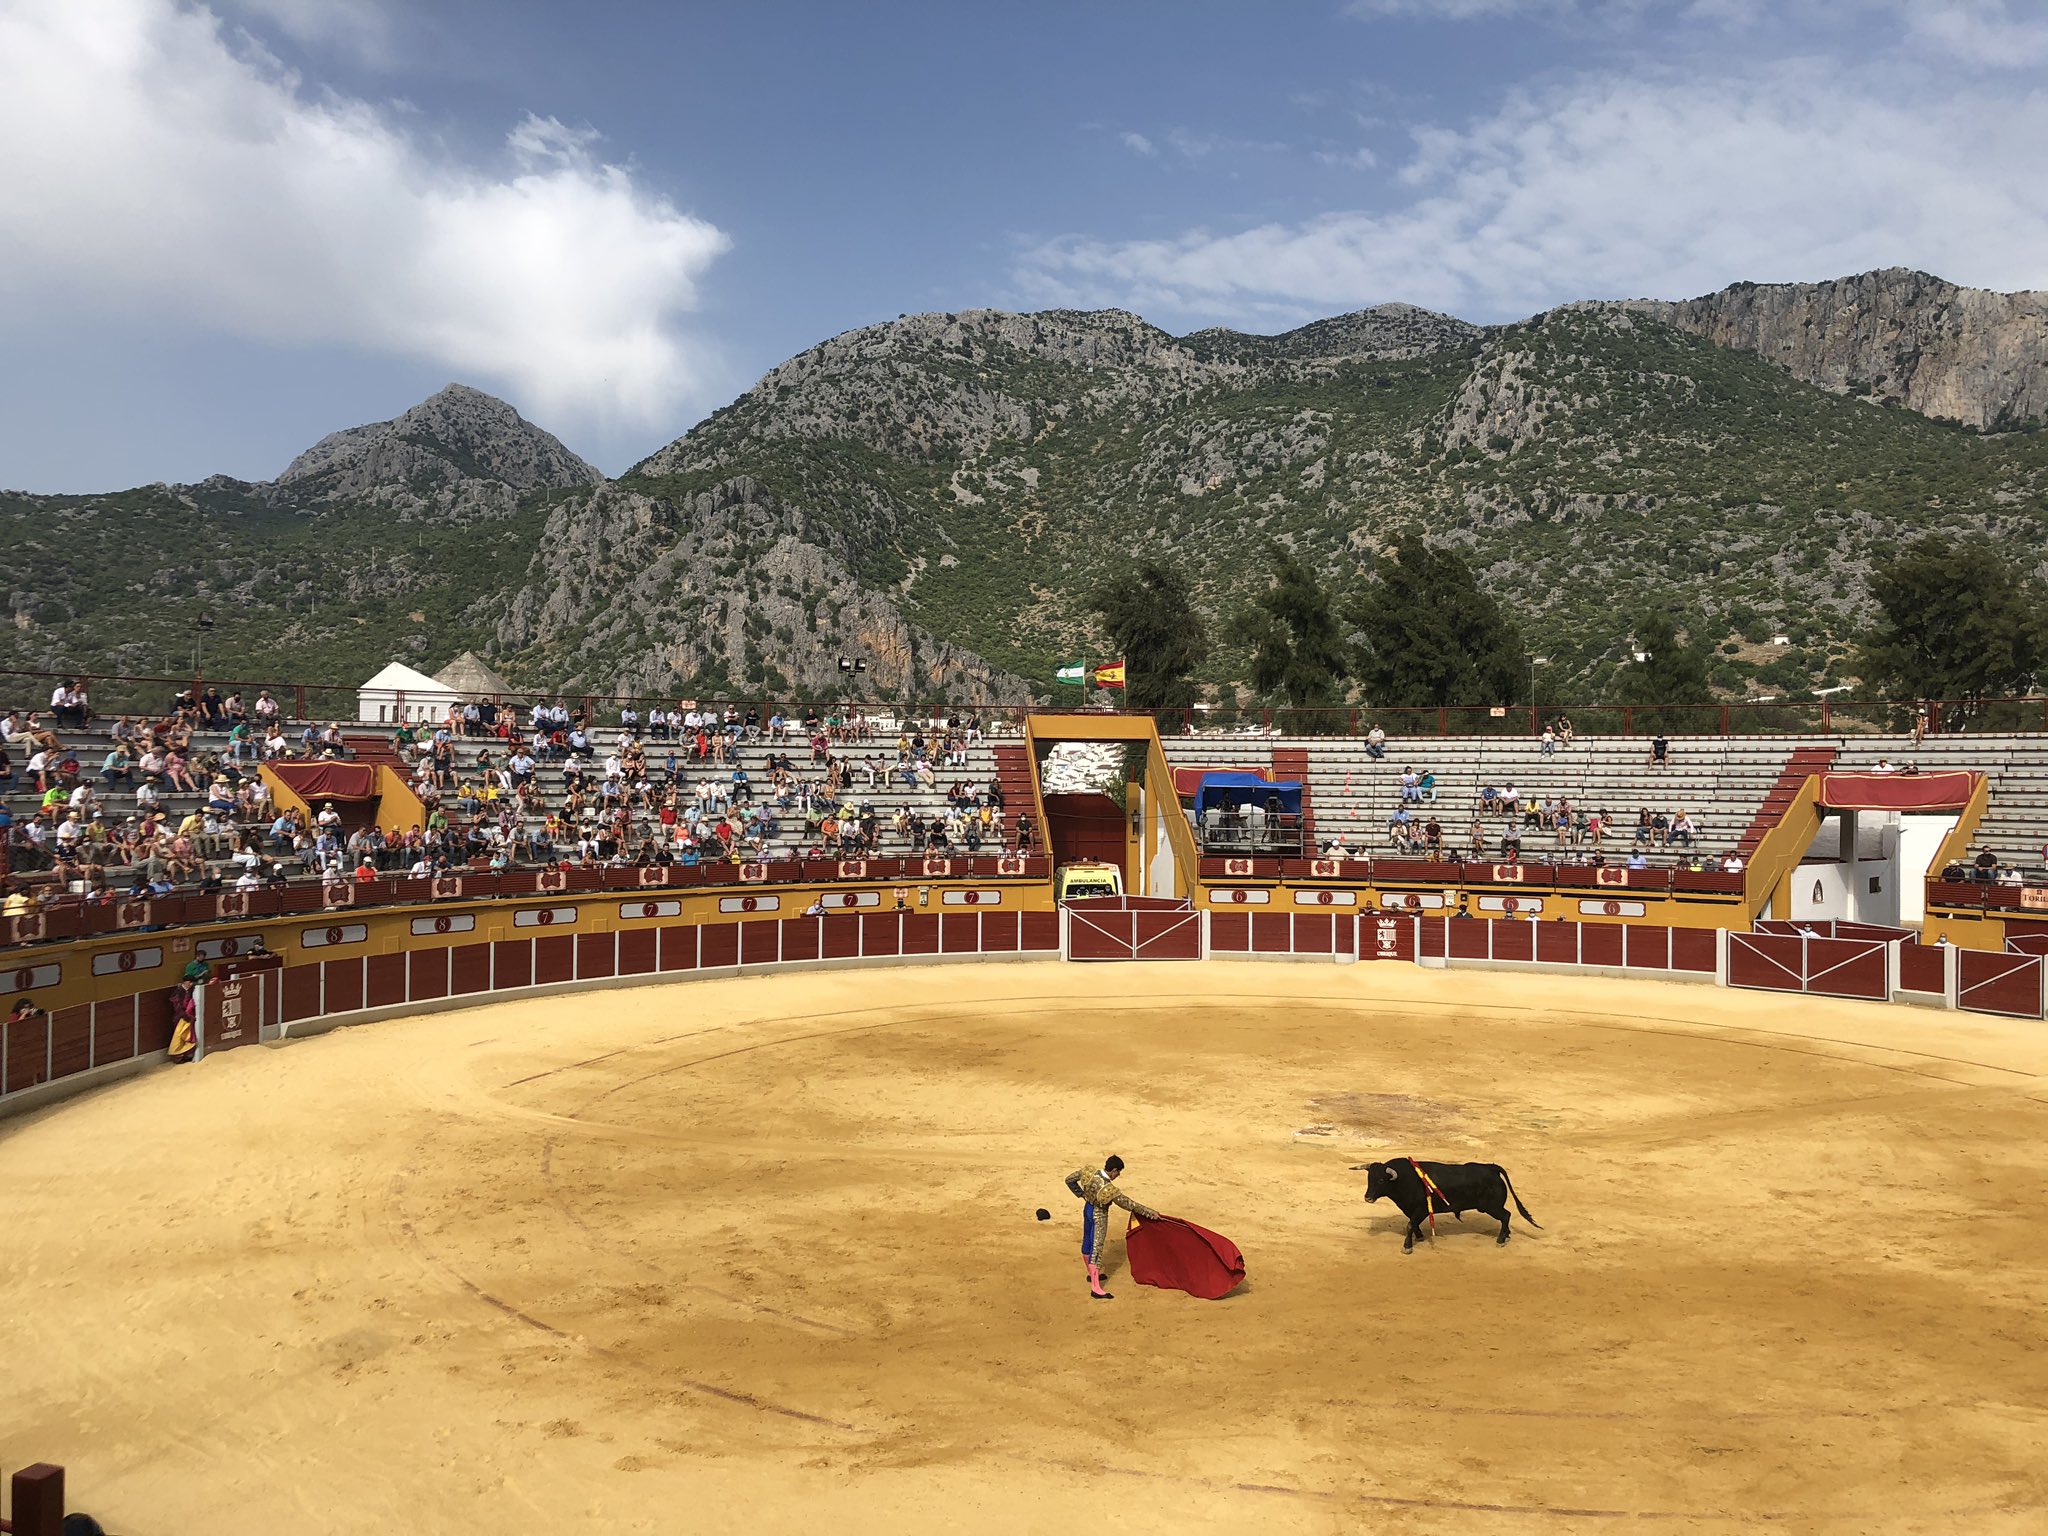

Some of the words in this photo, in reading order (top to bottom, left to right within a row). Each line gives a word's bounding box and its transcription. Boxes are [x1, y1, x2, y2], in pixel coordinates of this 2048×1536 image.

[848, 896, 853, 905] 7
[968, 893, 974, 902] 7
[1236, 892, 1242, 902] 6
[1322, 893, 1328, 903] 6
[1409, 896, 1415, 906] 6
[747, 900, 753, 909] 7
[1508, 898, 1514, 908] 6
[648, 905, 654, 915] 7
[1609, 904, 1615, 913] 6
[543, 913, 549, 923] 7
[439, 919, 445, 930] 8
[331, 929, 338, 941] 8
[226, 941, 233, 953] 8
[124, 954, 131, 967] 8
